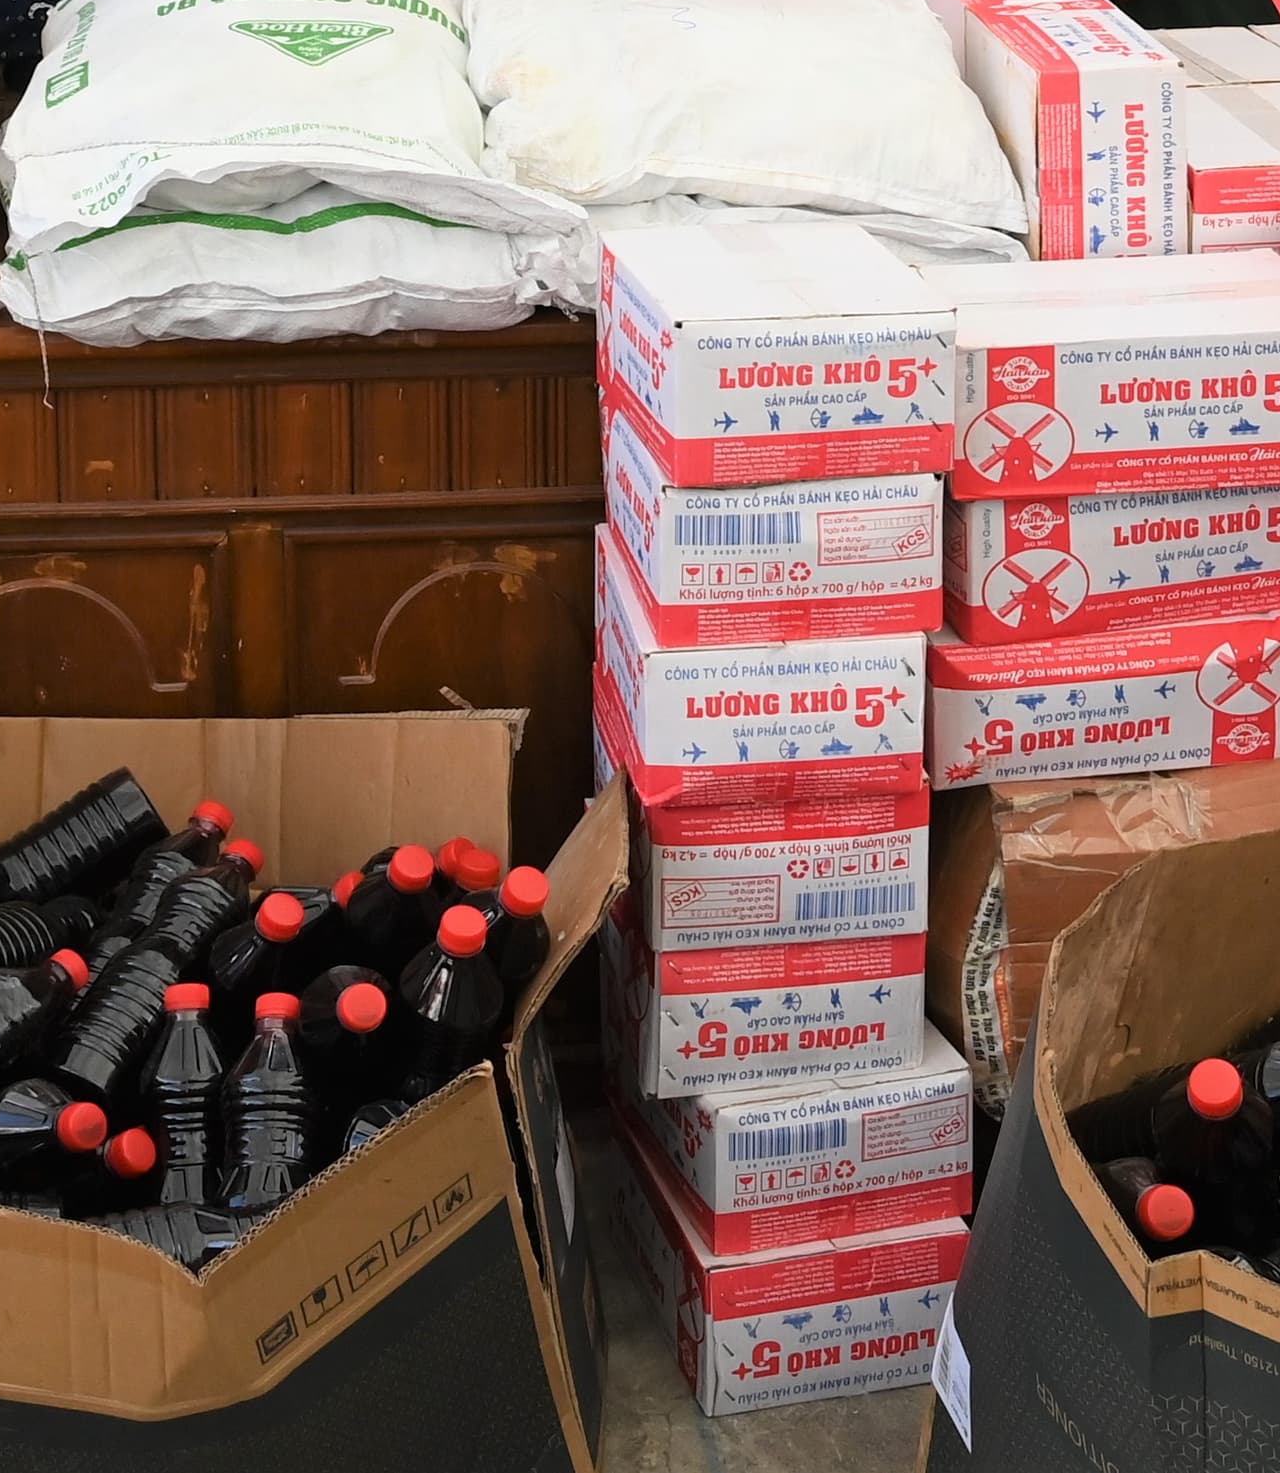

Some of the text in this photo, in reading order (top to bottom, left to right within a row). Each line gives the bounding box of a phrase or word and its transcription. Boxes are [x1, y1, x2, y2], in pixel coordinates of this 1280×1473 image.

[1125, 104, 1152, 247] LƯƠNG KHÔ
[1060, 352, 1093, 365] CÔNG
[1098, 351, 1112, 363] TY
[1115, 345, 1132, 362] CỔ
[1136, 344, 1166, 361] PHẦN
[1170, 346, 1203, 360] BÁNH
[1206, 346, 1230, 361] KẸO
[1233, 342, 1252, 357] HẢI
[1100, 376, 1191, 405] LƯƠNG
[1201, 370, 1256, 399] KHÔ
[686, 486, 918, 509] CÔNG TY CỔ PHẦN BÁNH KẸO HẢI CHÂU
[897, 530, 926, 553] KCS
[680, 586, 706, 600] Khối
[709, 587, 743, 603] lượng
[776, 586, 784, 596] 6
[786, 584, 809, 600] hộp
[822, 583, 843, 594] 700
[847, 581, 858, 594] g/
[862, 580, 884, 596] hộp
[900, 577, 917, 589] 4,2
[920, 576, 933, 590] kg
